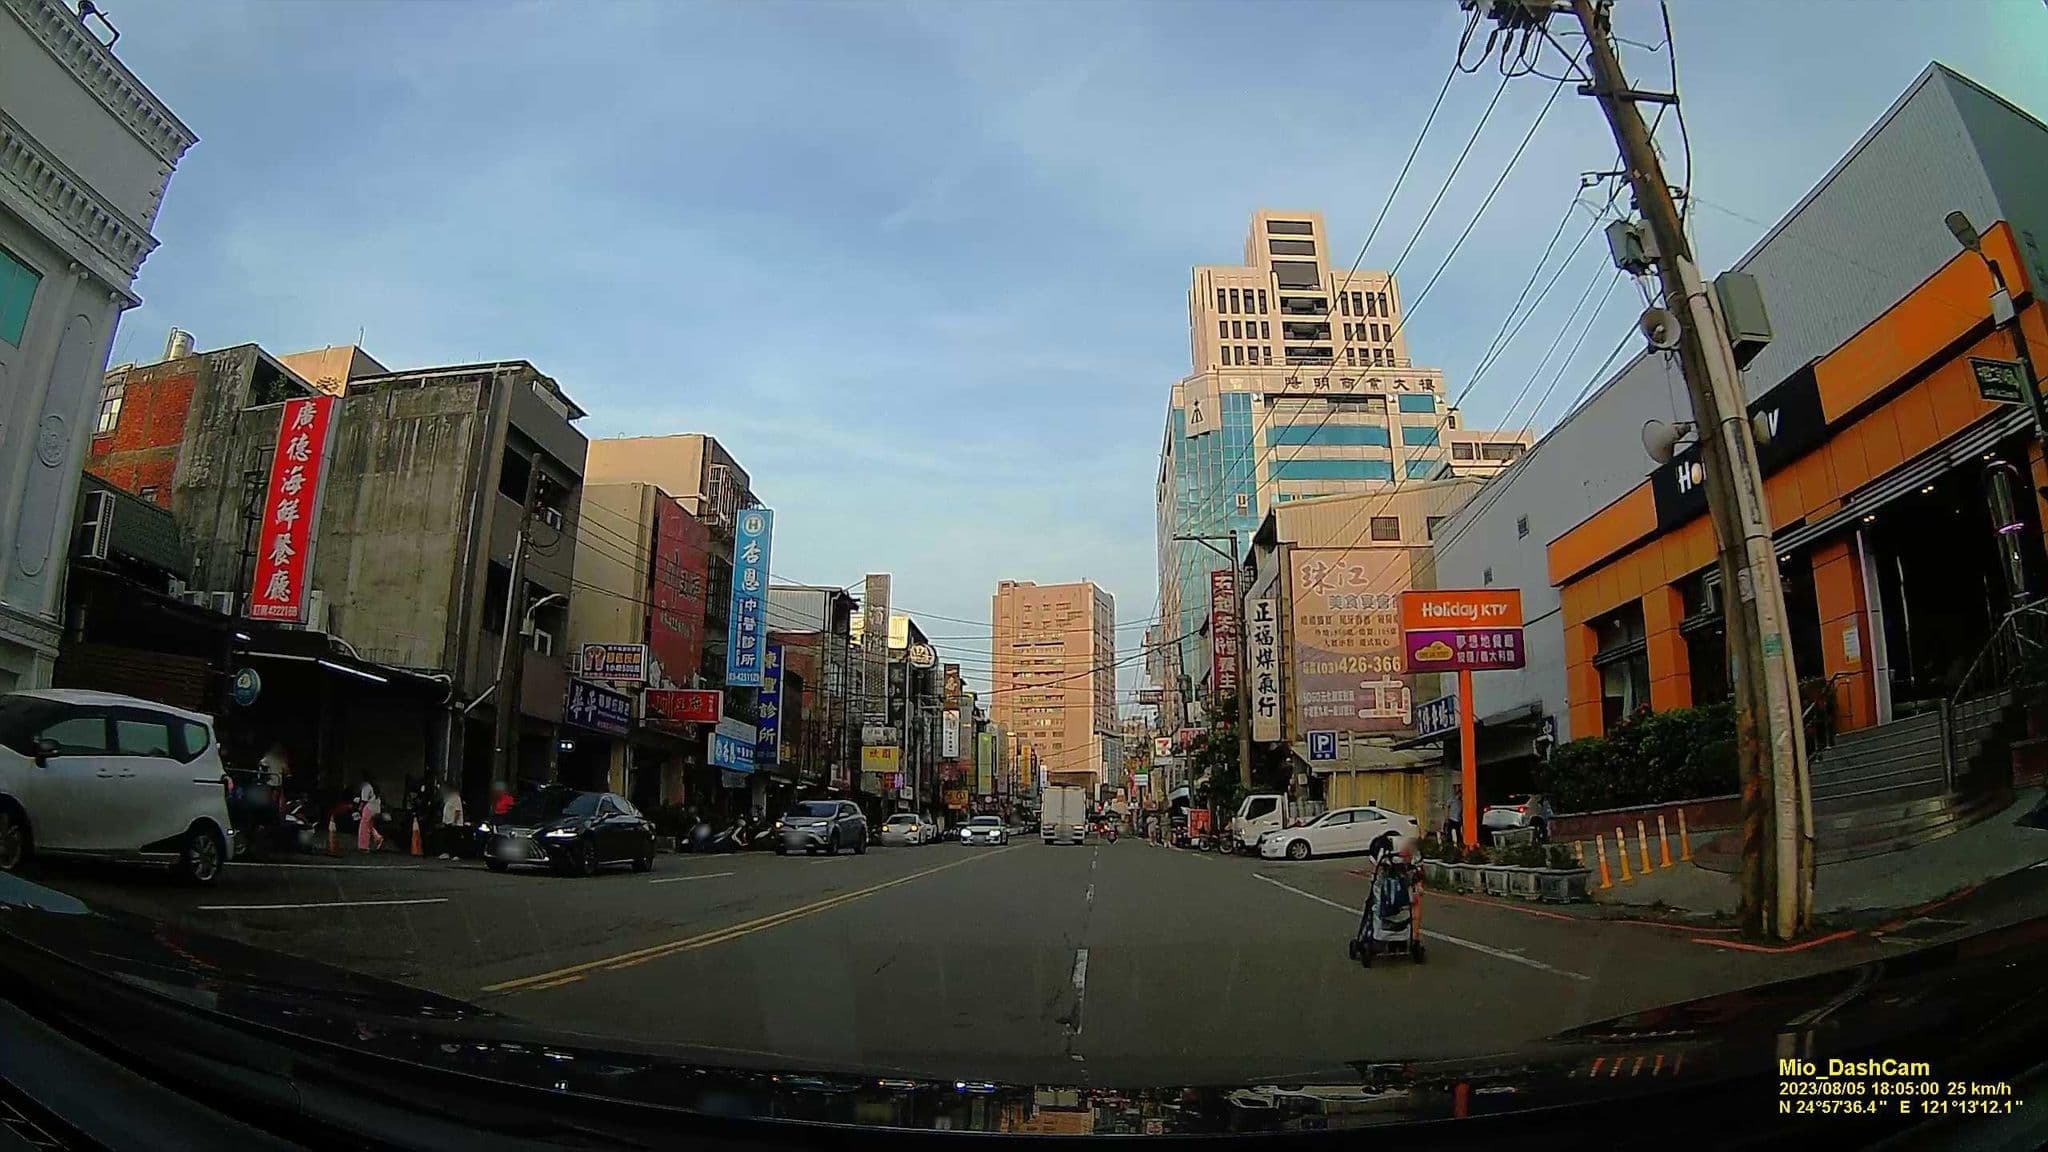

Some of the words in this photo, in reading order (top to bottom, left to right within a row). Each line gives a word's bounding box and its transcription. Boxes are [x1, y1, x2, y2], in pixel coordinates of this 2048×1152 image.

[1284, 376, 1436, 392] 陽明商業大樓
[263, 401, 318, 603] 廣德海鮮餐廳
[1300, 561, 1370, 596] 珠江
[1422, 601, 1479, 621] Holiday
[1481, 603, 1509, 616] KTV
[1456, 634, 1515, 649] 夢想地餐廳
[1253, 602, 1278, 718] 正福煤氣行
[1317, 735, 1330, 751] P
